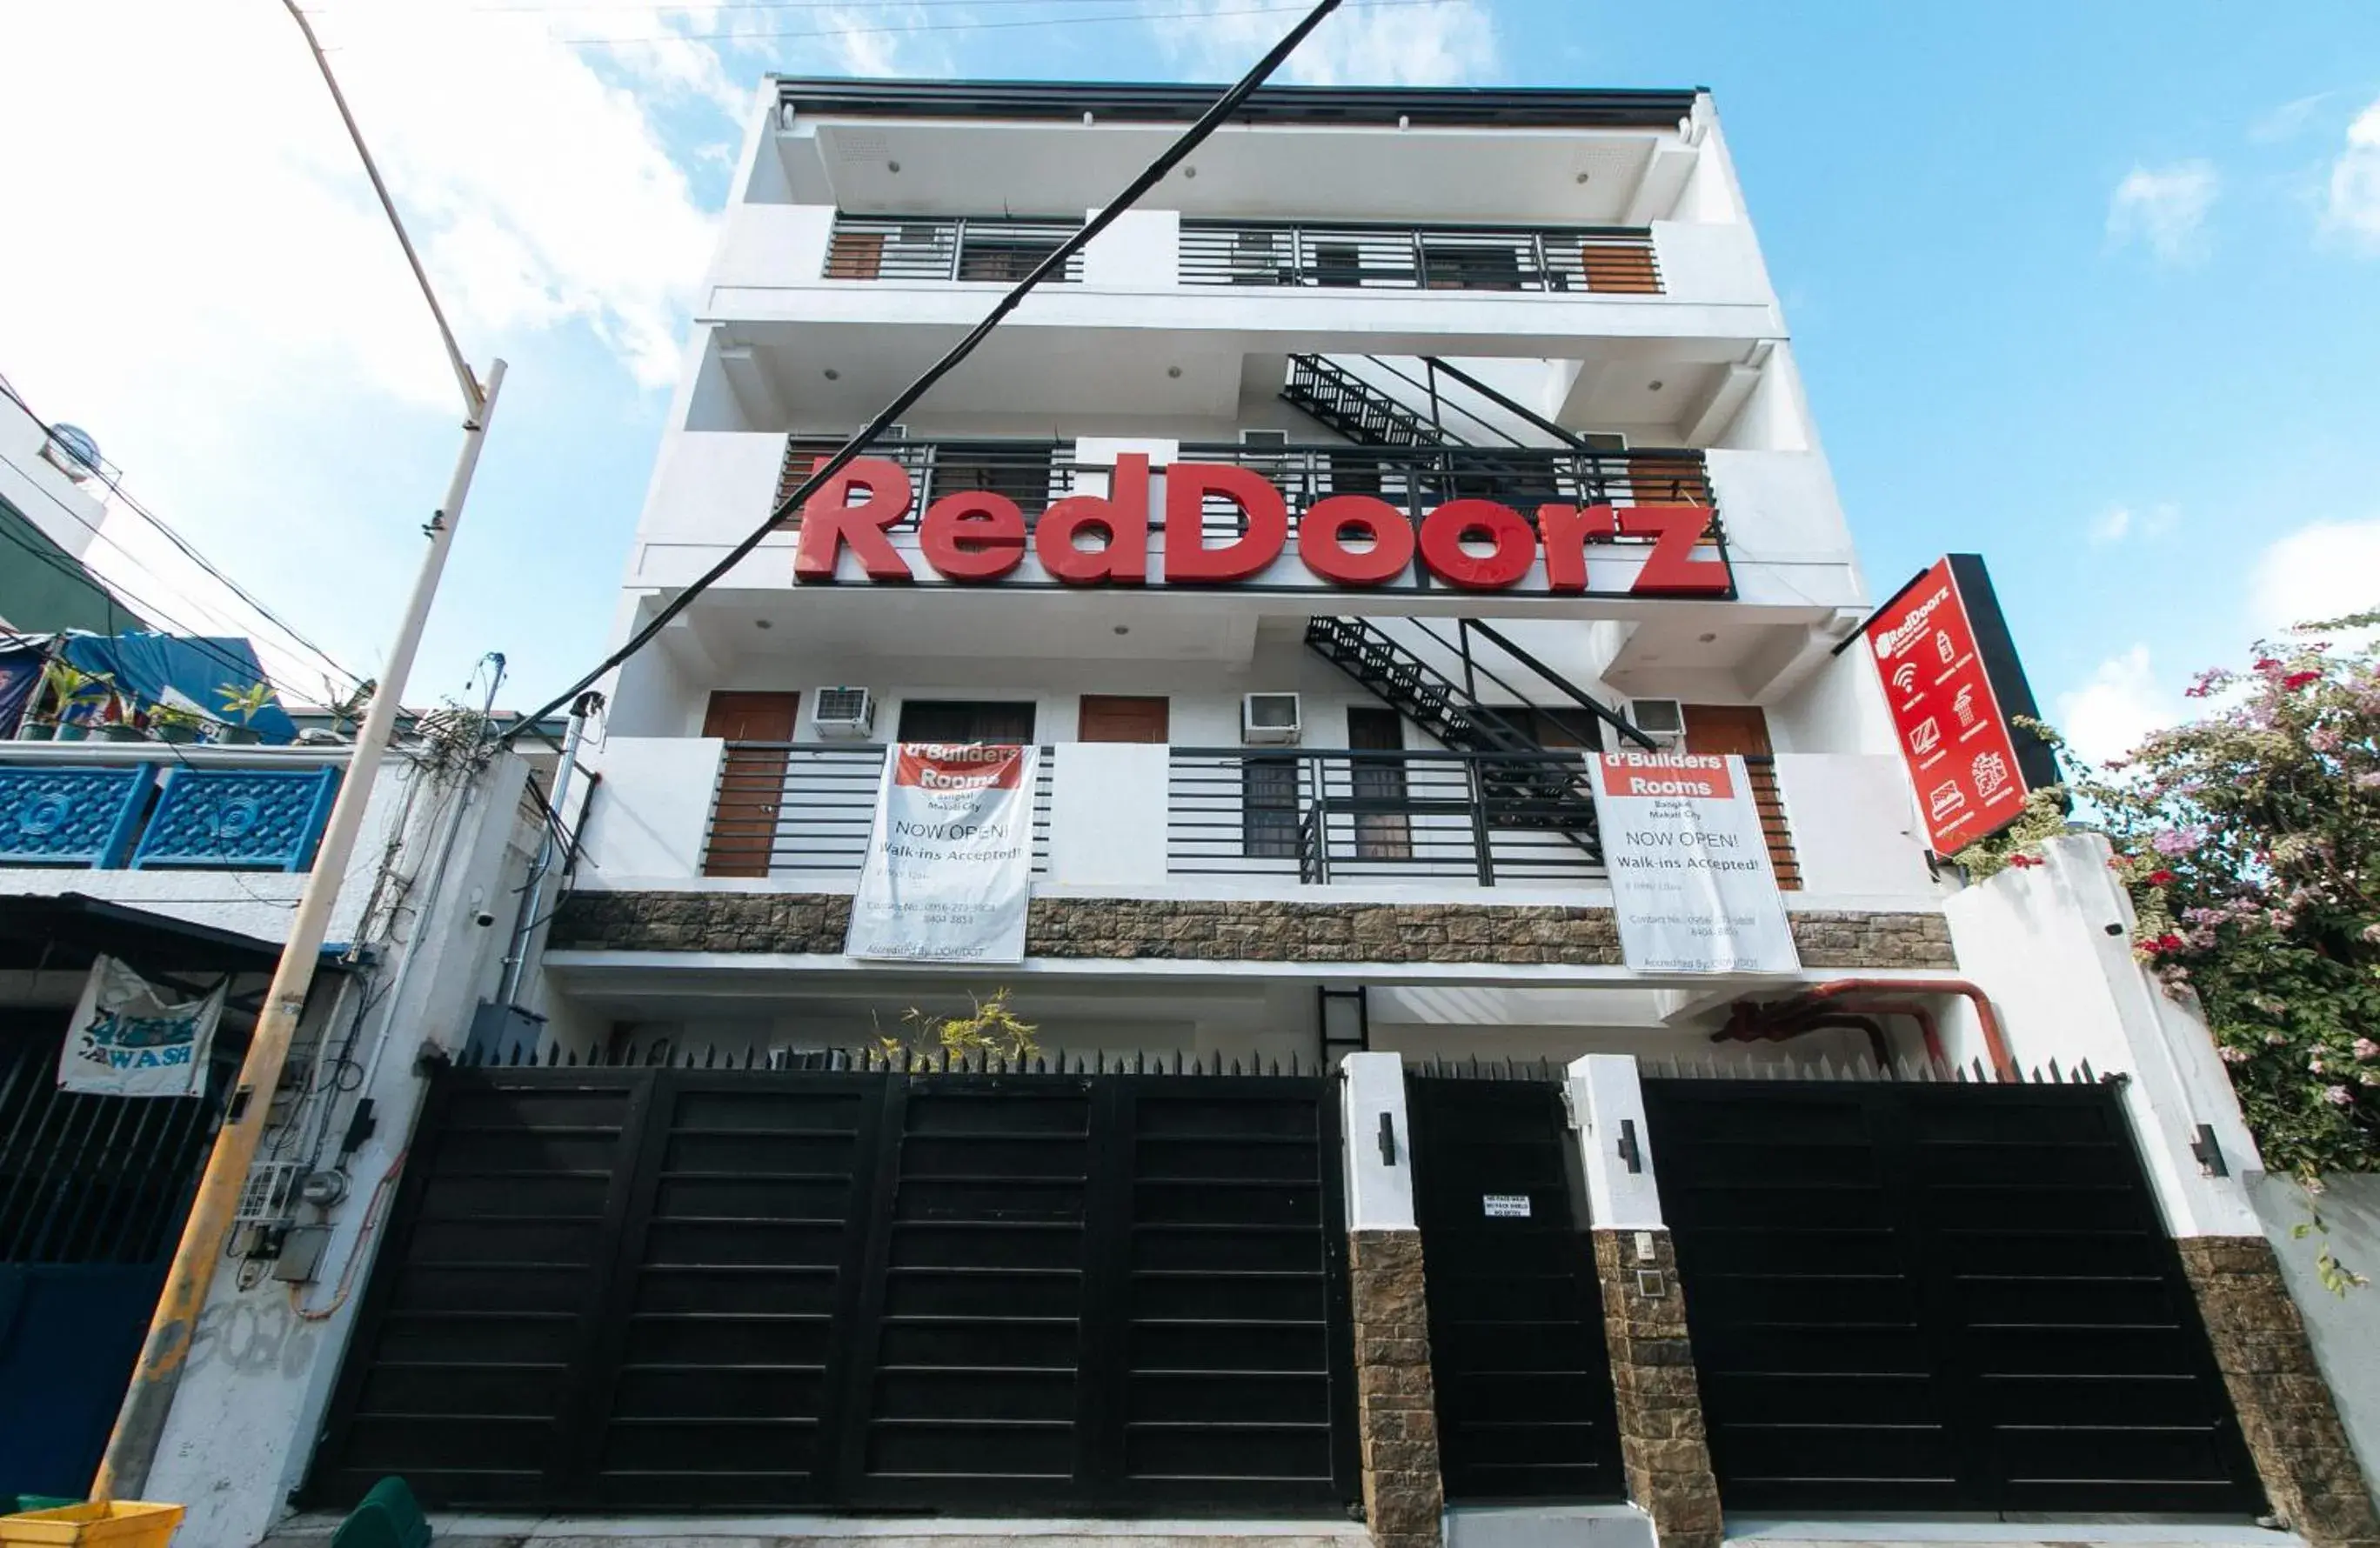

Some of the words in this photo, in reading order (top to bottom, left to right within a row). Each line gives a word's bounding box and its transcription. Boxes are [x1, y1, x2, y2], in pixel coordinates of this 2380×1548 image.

[792, 453, 1731, 596] RedDoorz
[1889, 585, 1949, 645] RedDoorz
[1606, 753, 1721, 769] d'Builders
[1629, 776, 1713, 796] Rooms
[895, 821, 946, 838] NOW
[949, 823, 1009, 841] OPEN!
[1626, 831, 1674, 847] NOW
[1679, 831, 1740, 848] OPEN!
[879, 842, 942, 860] Walk-ins
[946, 847, 1023, 863] Accepted!
[1615, 855, 1681, 869] Walk-ins
[1687, 856, 1759, 871] Accepted!
